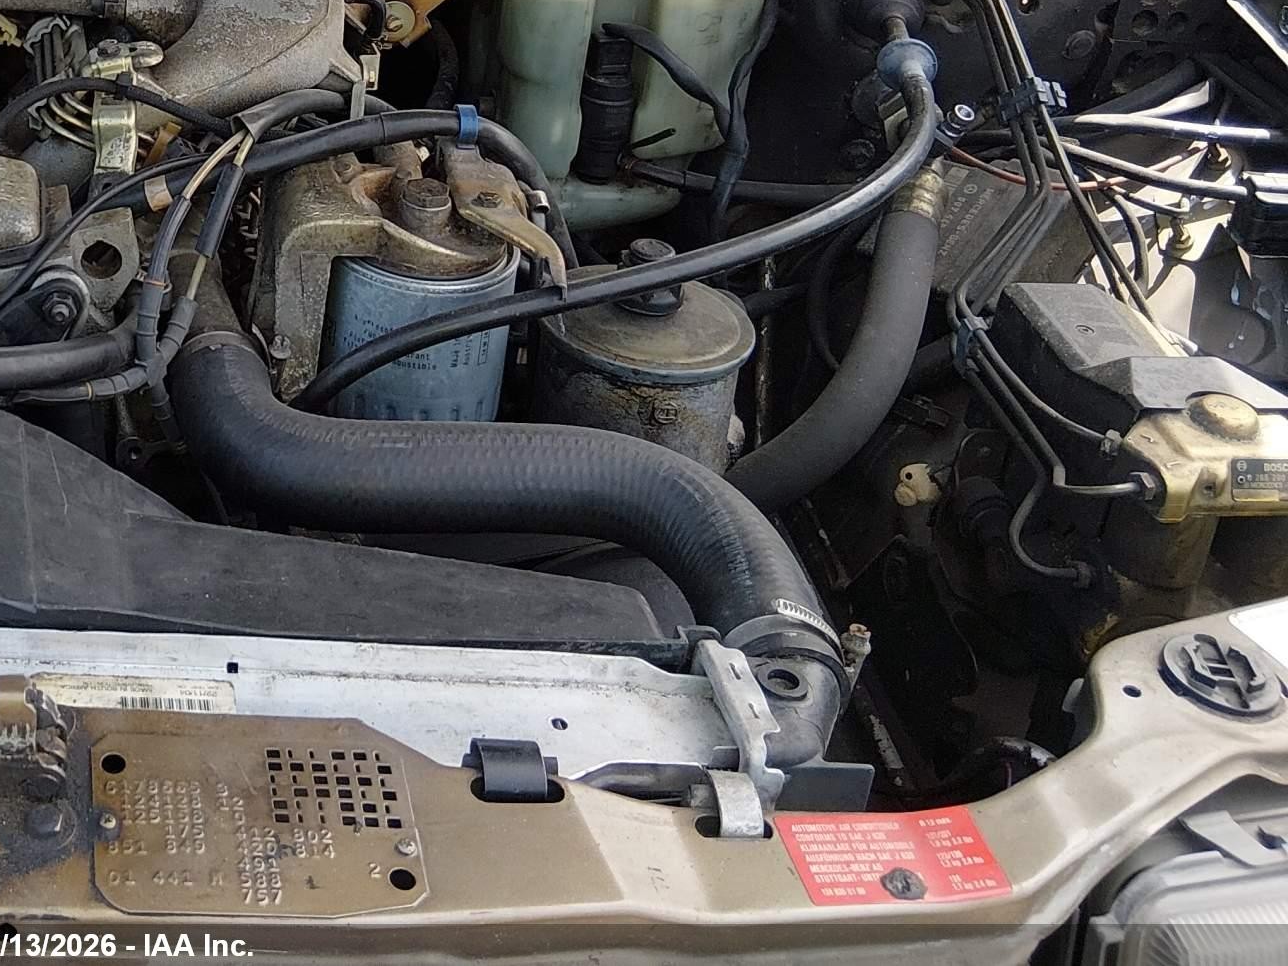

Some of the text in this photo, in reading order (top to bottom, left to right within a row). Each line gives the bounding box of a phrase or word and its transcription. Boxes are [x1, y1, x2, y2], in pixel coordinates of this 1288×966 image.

[792, 824, 836, 832] AUTOMOTIVE
[839, 823, 851, 831] AIR
[237, 841, 277, 857] 420
[800, 842, 852, 852] KLIMAANLAGE
[805, 852, 855, 862] AUSFÜHRUNG
[856, 852, 876, 861] NACH
[238, 856, 382, 878] 491 2
[809, 862, 884, 873] MERCEDES-BENZ AG
[241, 889, 283, 906] 757
